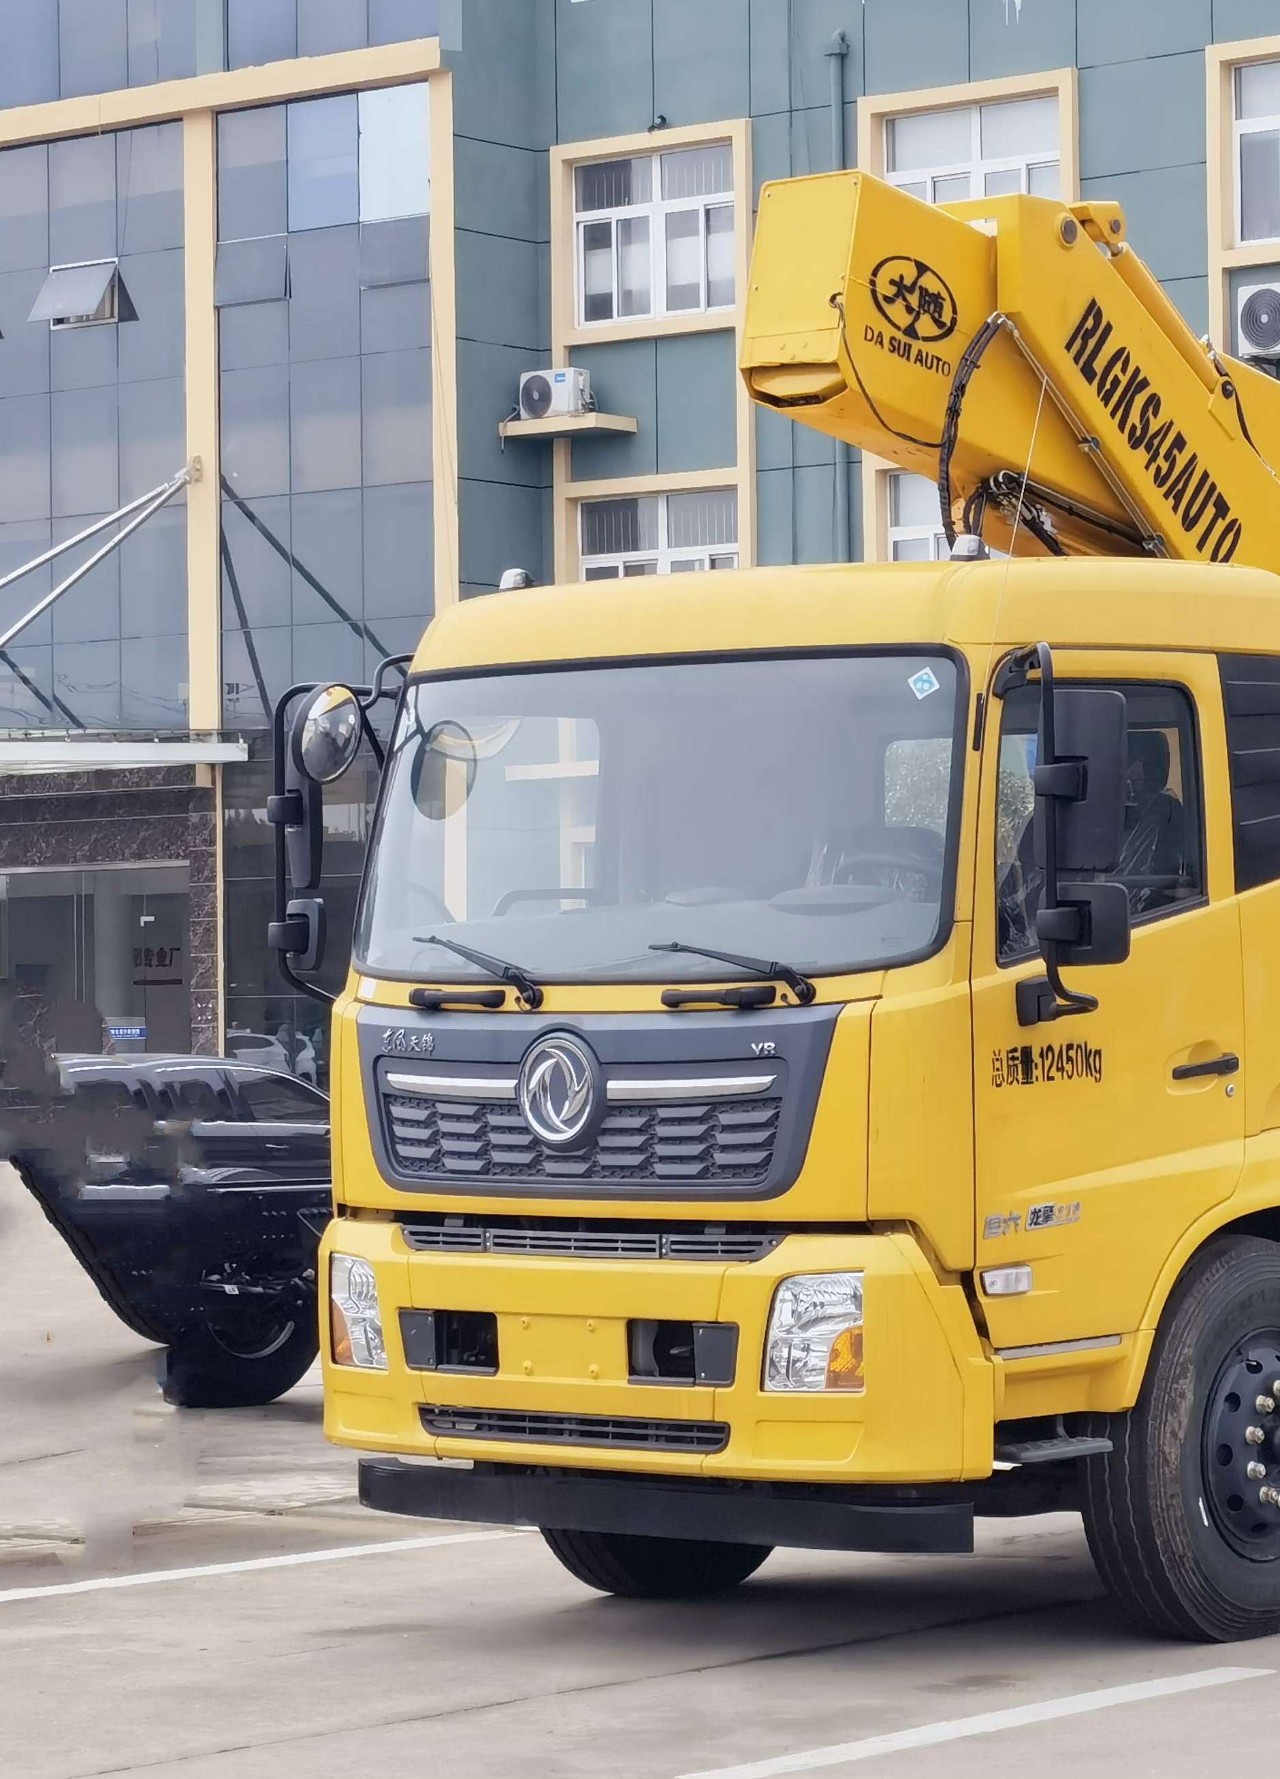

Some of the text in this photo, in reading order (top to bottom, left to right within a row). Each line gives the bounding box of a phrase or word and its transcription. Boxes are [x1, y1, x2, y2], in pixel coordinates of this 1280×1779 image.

[864, 324, 951, 377] DA SUI AUTO
[1064, 296, 1242, 563] RLGKS45AUTO
[750, 1042, 776, 1056] VR
